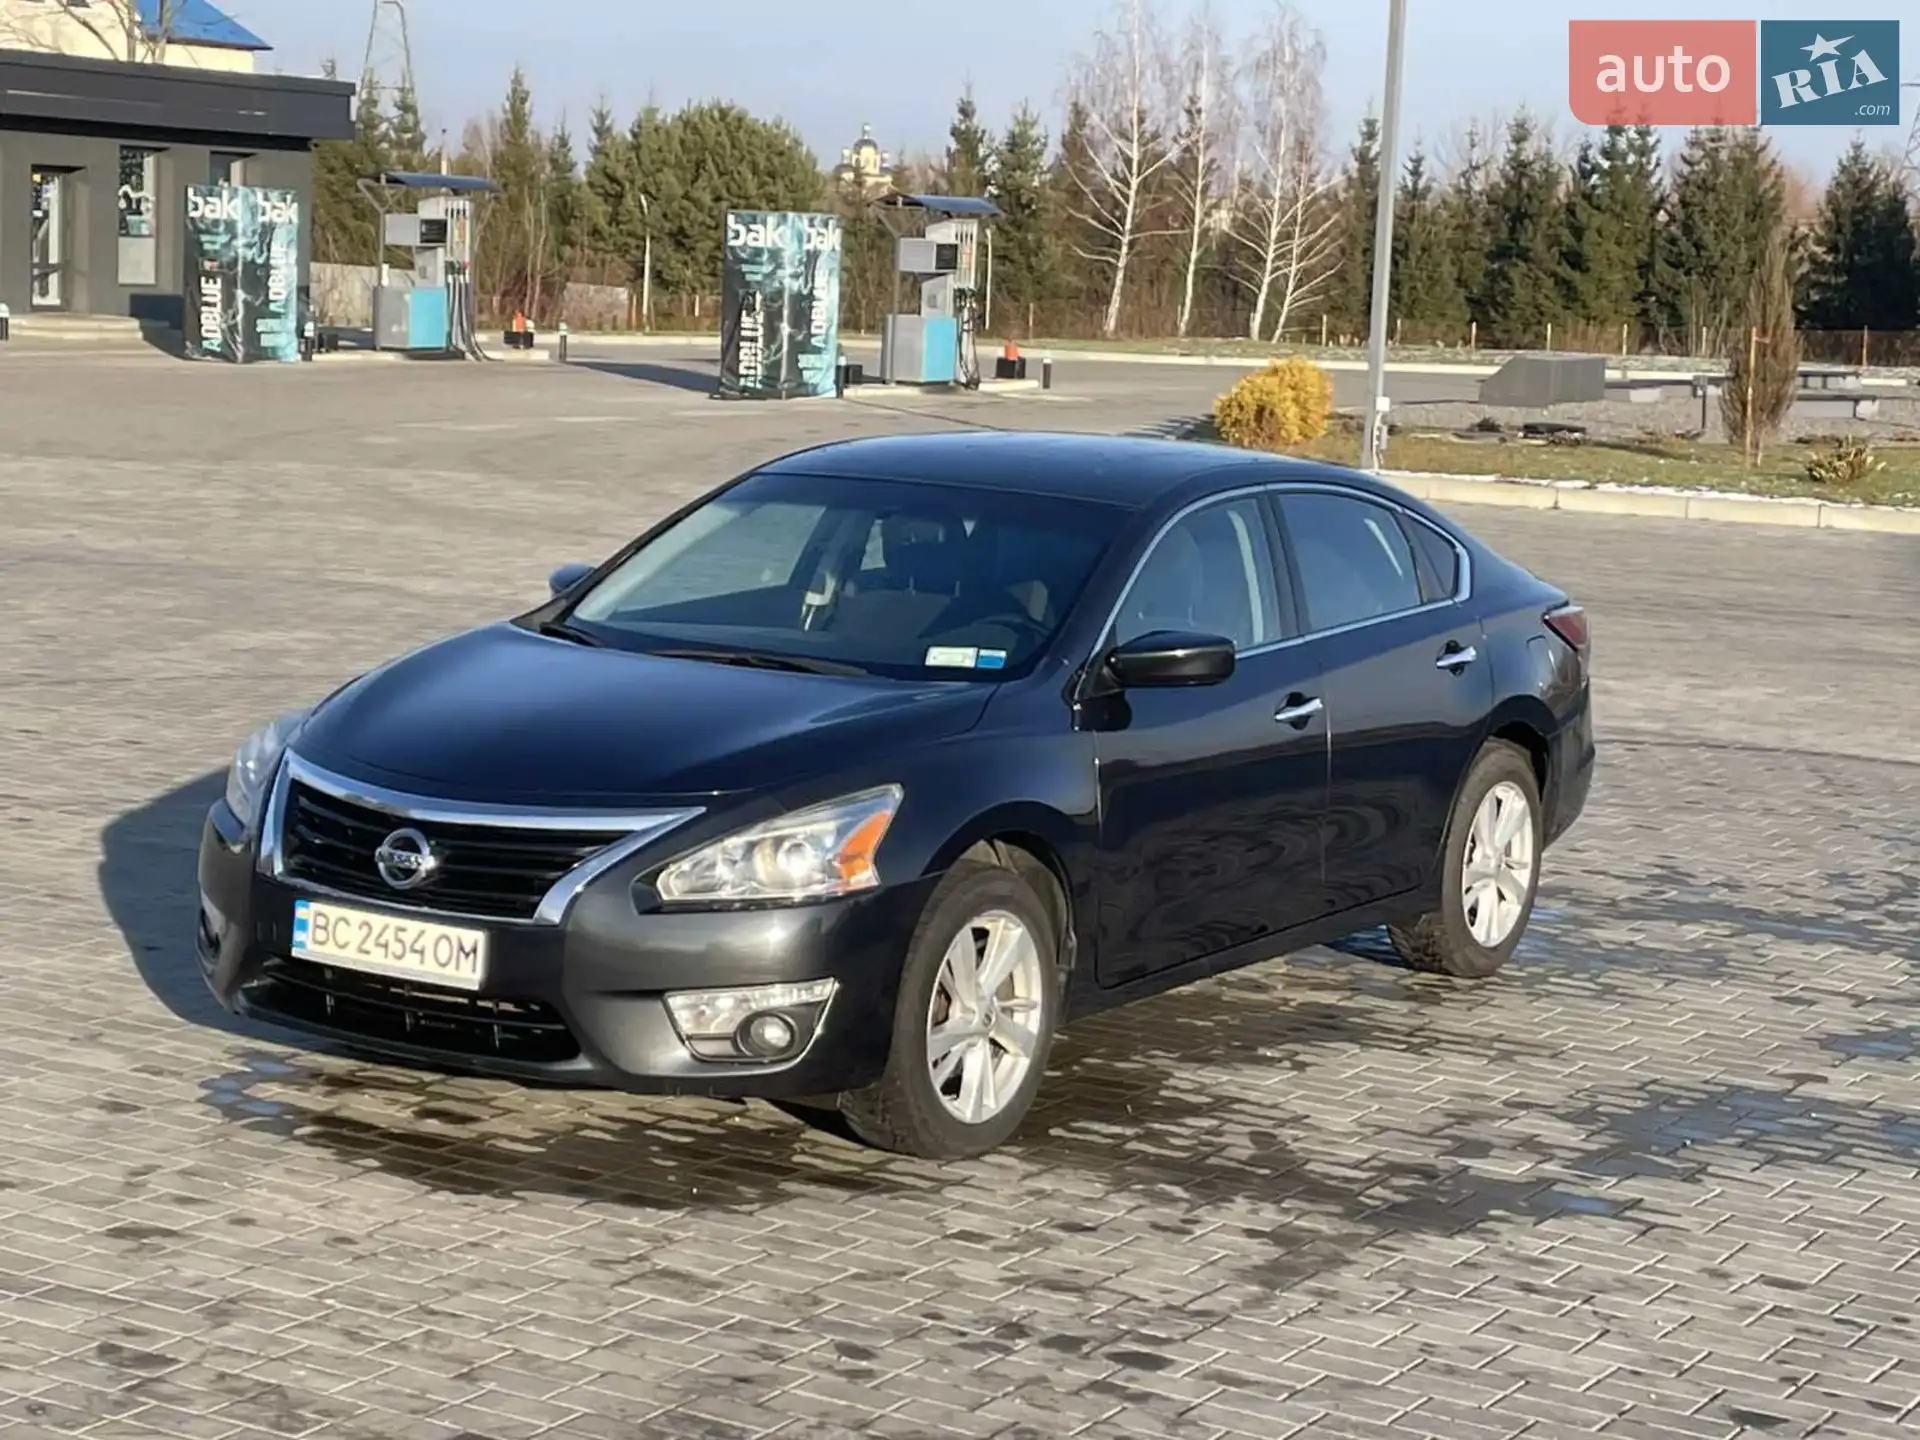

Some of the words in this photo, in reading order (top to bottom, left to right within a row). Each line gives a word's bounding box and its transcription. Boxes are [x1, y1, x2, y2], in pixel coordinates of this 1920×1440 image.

[187, 187, 240, 220] bak
[257, 191, 299, 223] bak
[727, 214, 784, 248] bak
[803, 218, 841, 251] bak
[200, 276, 223, 353] ADBLUE
[311, 911, 351, 950] BC
[356, 921, 427, 965] 2454
[433, 933, 479, 974] OM
